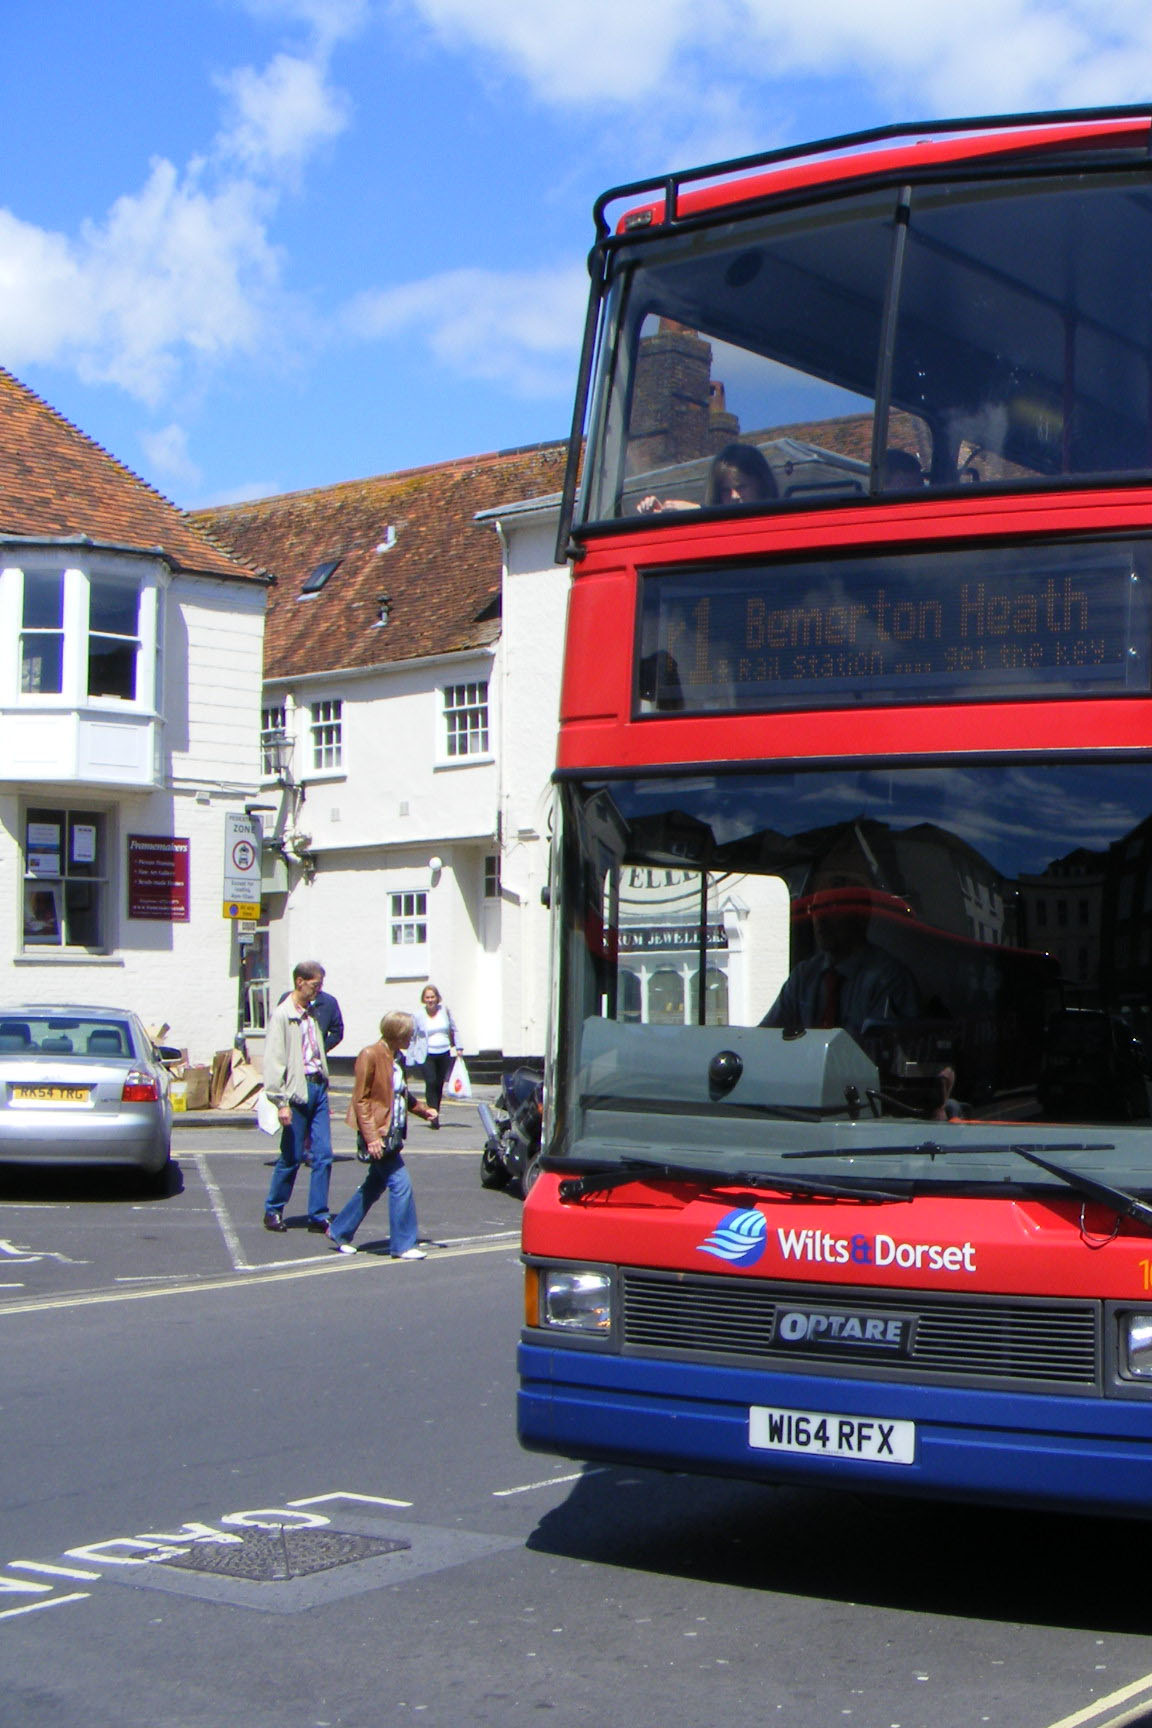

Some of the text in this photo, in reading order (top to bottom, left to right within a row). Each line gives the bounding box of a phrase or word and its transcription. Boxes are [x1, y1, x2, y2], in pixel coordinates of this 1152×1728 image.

[746, 577, 1088, 649] Bemerton Heath
[233, 824, 256, 834] ZONE
[20, 1087, 84, 1100] RK54 YRG
[776, 1227, 850, 1265] Wilts
[875, 1234, 977, 1273] Dorset
[779, 1312, 903, 1343] OPTARE
[768, 1413, 895, 1455] W164 RFX
